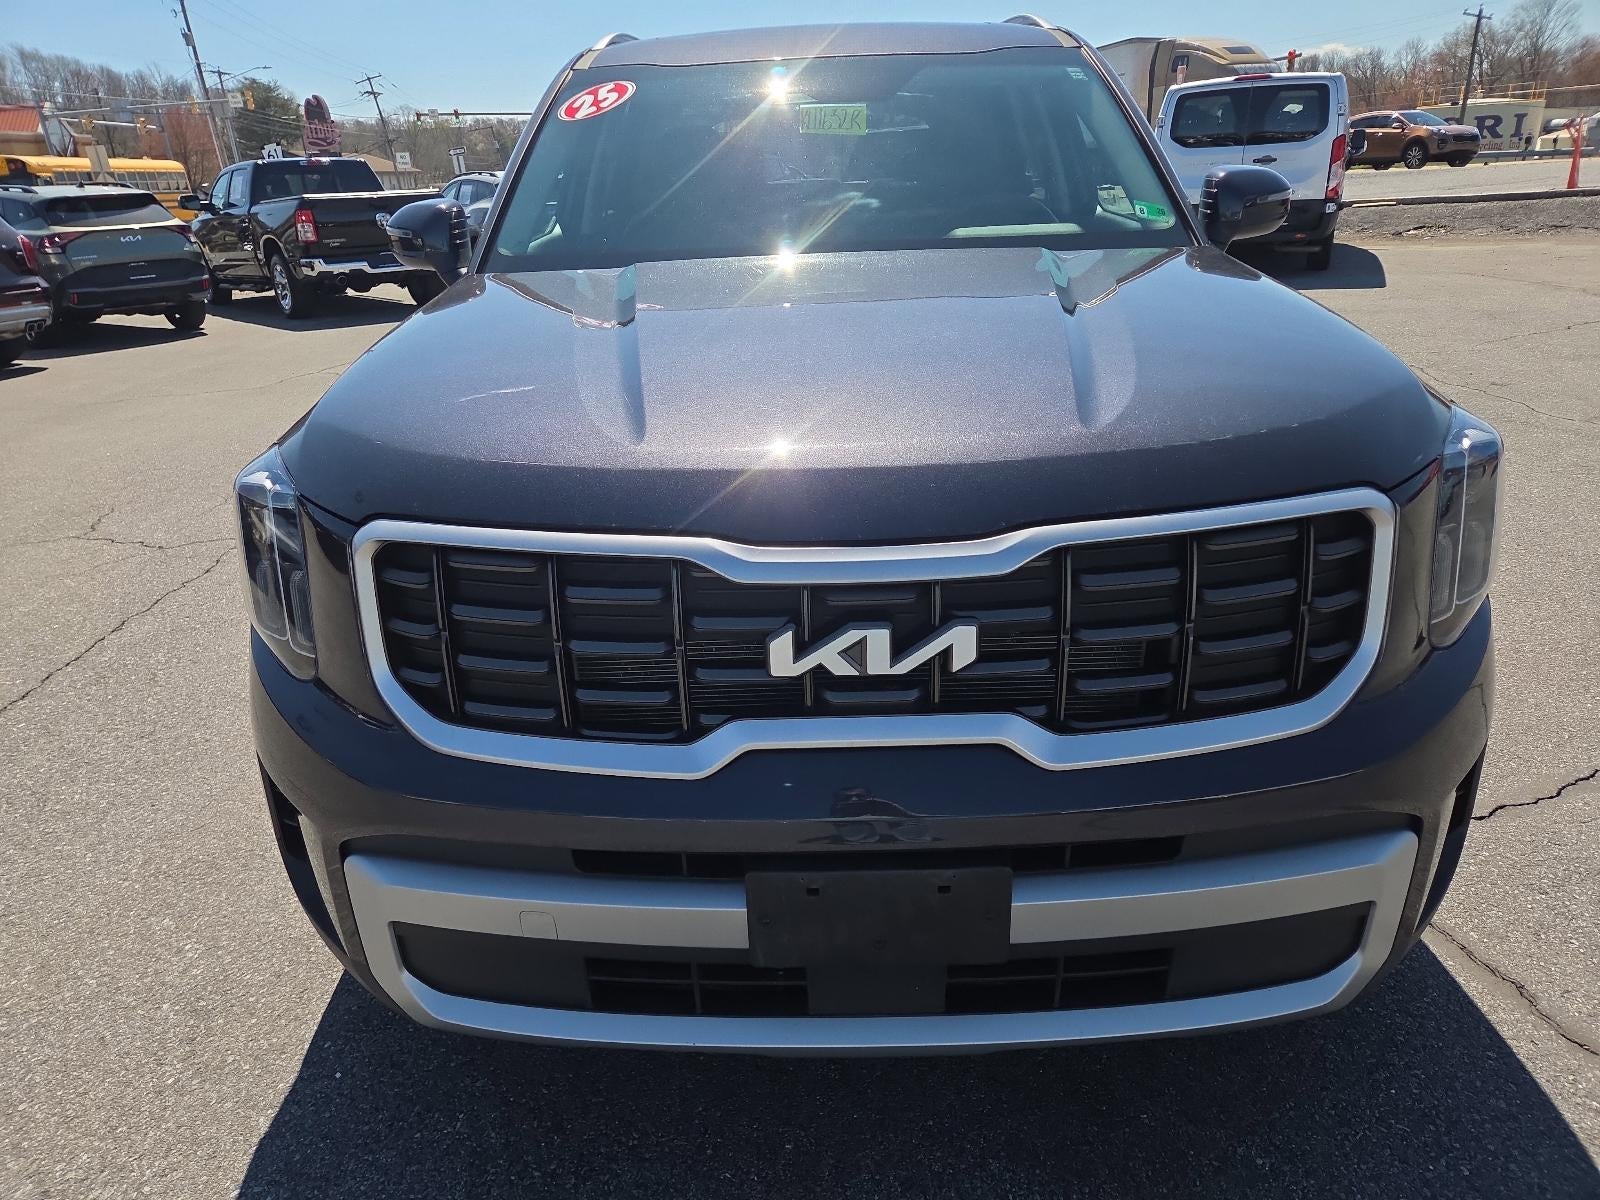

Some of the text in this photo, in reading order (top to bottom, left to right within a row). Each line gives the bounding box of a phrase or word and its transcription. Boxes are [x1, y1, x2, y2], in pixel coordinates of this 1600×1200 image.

[571, 83, 620, 119] 25
[267, 148, 279, 160] 61
[768, 624, 979, 678] KIA
